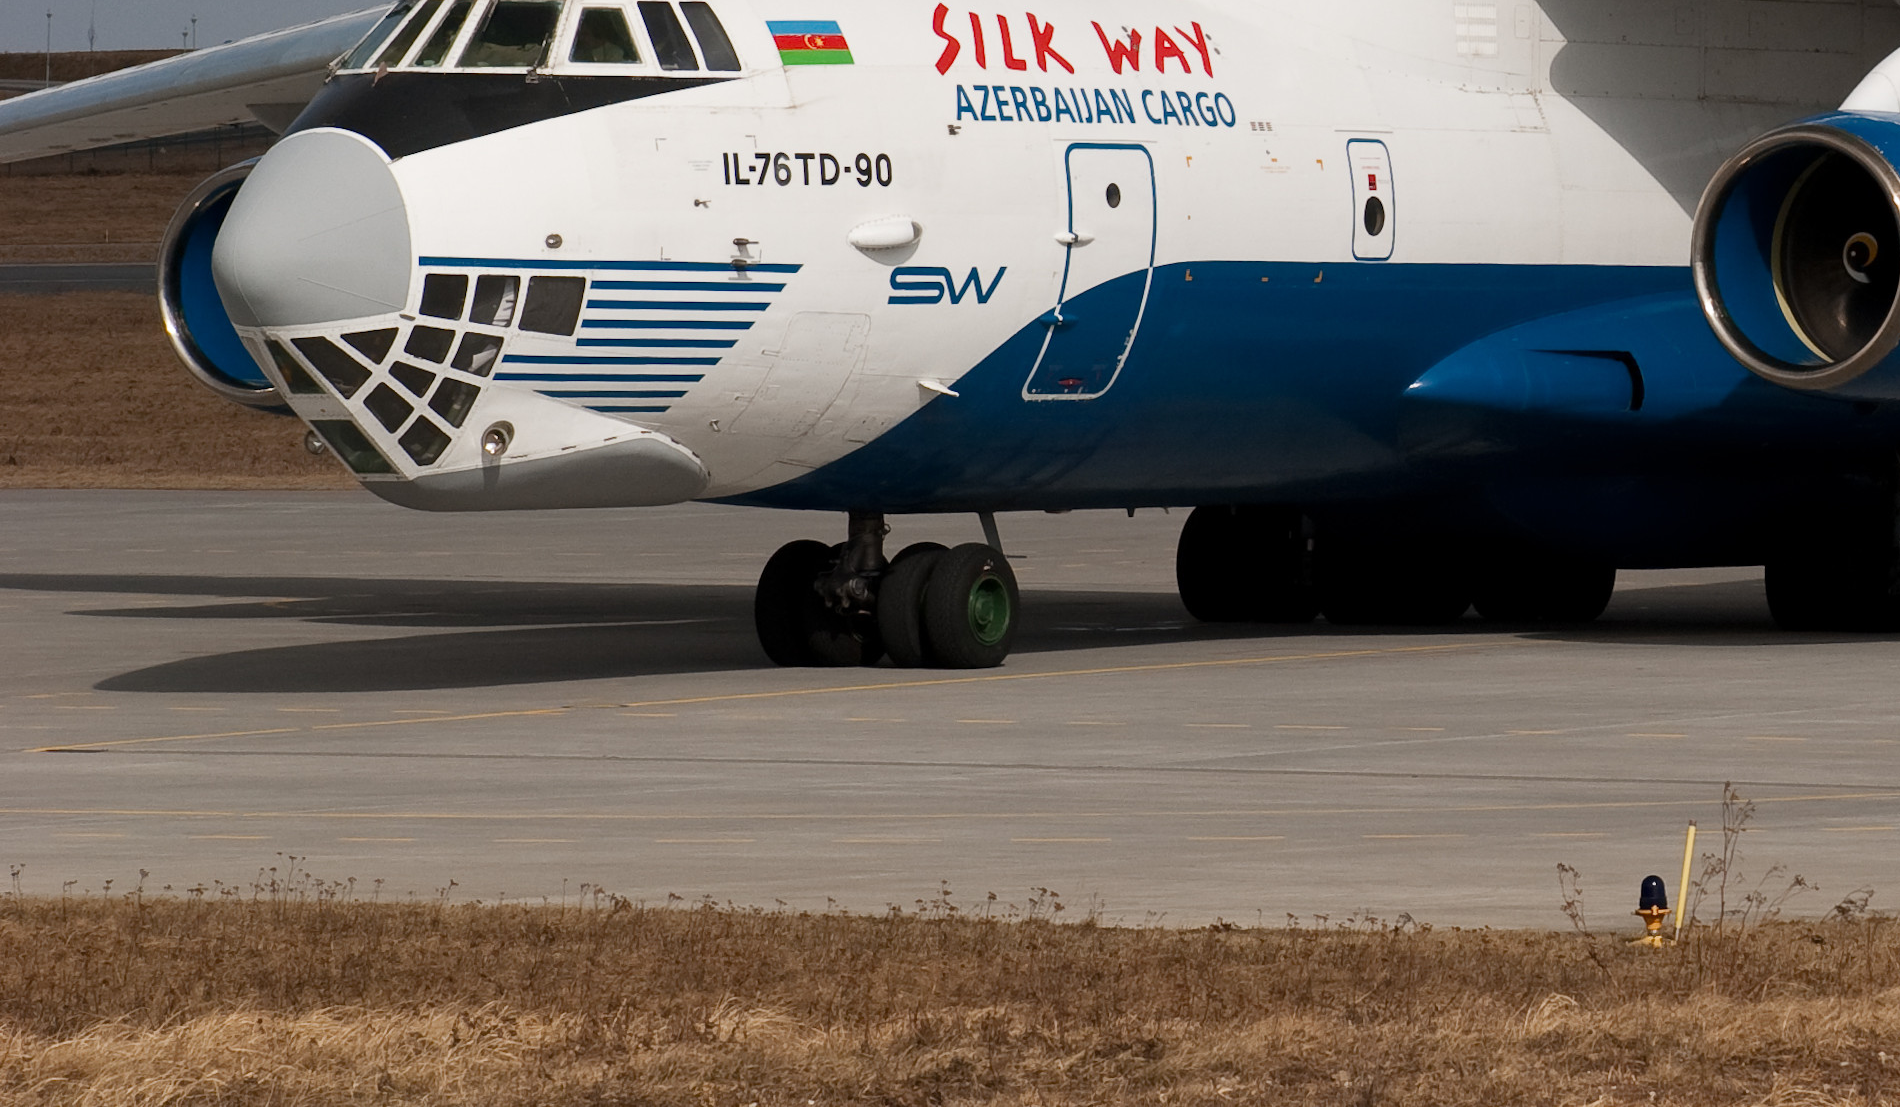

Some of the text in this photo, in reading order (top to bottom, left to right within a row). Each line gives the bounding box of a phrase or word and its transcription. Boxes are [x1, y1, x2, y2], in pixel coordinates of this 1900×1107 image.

[932, 2, 1214, 79] SILK WAY
[956, 84, 1236, 128] AZERBAIJAN CARGO
[722, 151, 893, 188] IL-76TD-90
[887, 266, 1008, 305] SW
